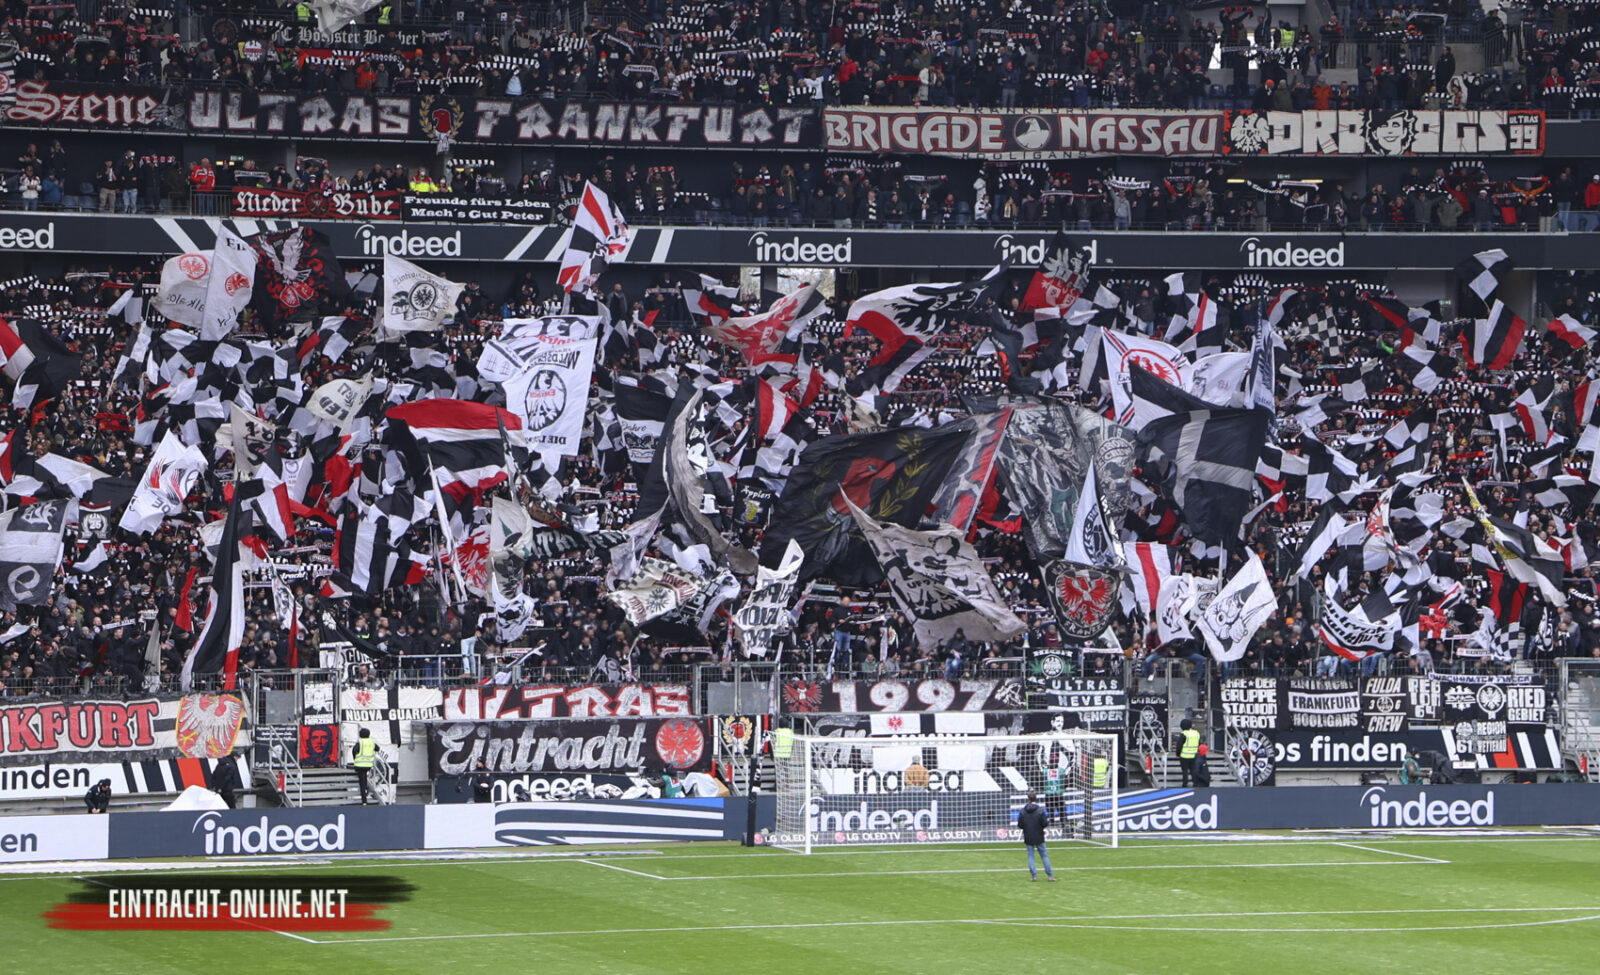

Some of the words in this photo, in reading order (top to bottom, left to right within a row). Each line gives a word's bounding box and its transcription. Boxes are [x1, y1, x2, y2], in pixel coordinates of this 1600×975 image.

[6, 81, 159, 124] Szene
[189, 91, 412, 135] ULTRAS
[474, 101, 814, 143] FRANKFURT
[1509, 115, 1539, 125] ULTRAS
[825, 111, 1006, 153] BRIGADE
[1059, 113, 1220, 156] NASSAU
[1509, 125, 1539, 150] 99
[236, 191, 301, 213] Nieder
[332, 193, 394, 216] Bube
[403, 195, 465, 206] Freunde
[468, 196, 497, 207] fürs
[500, 198, 551, 210] Leben
[469, 208, 498, 220] Gut
[501, 210, 544, 222] Peter
[355, 225, 462, 257] indeed
[749, 231, 852, 263] indeed
[1241, 237, 1345, 267] indeed
[1051, 679, 1119, 691] ULTRAS
[1366, 677, 1402, 694] FULDA
[444, 684, 692, 720] ULTRAS
[831, 679, 1000, 713] 1997
[1057, 695, 1115, 707] NEVER
[1221, 688, 1277, 703] GRUPPE
[1292, 695, 1359, 711] FRANKFURT
[1507, 688, 1545, 709] RIED
[345, 709, 383, 721] NUOVA
[388, 706, 440, 721] GUARDIA
[1222, 703, 1278, 715] STADION
[1415, 705, 1436, 718] 64
[1508, 708, 1546, 722] GEBIET
[1224, 715, 1278, 729] VERBOT
[1293, 712, 1359, 728] HOOLIGANS
[1368, 716, 1403, 733] CREW
[1477, 720, 1506, 736] REGION
[438, 722, 647, 776] Eintracht
[1310, 735, 1408, 762] finden
[1456, 739, 1472, 754] 61
[800, 797, 938, 832] indeed
[1361, 787, 1495, 827] indeed
[193, 811, 345, 855] indeed
[847, 832, 859, 840] LG
[862, 832, 887, 840] OLED
[888, 832, 901, 840] TV
[943, 831, 968, 839] OLED
[969, 830, 982, 838] TV
[1051, 829, 1063, 837] TV
